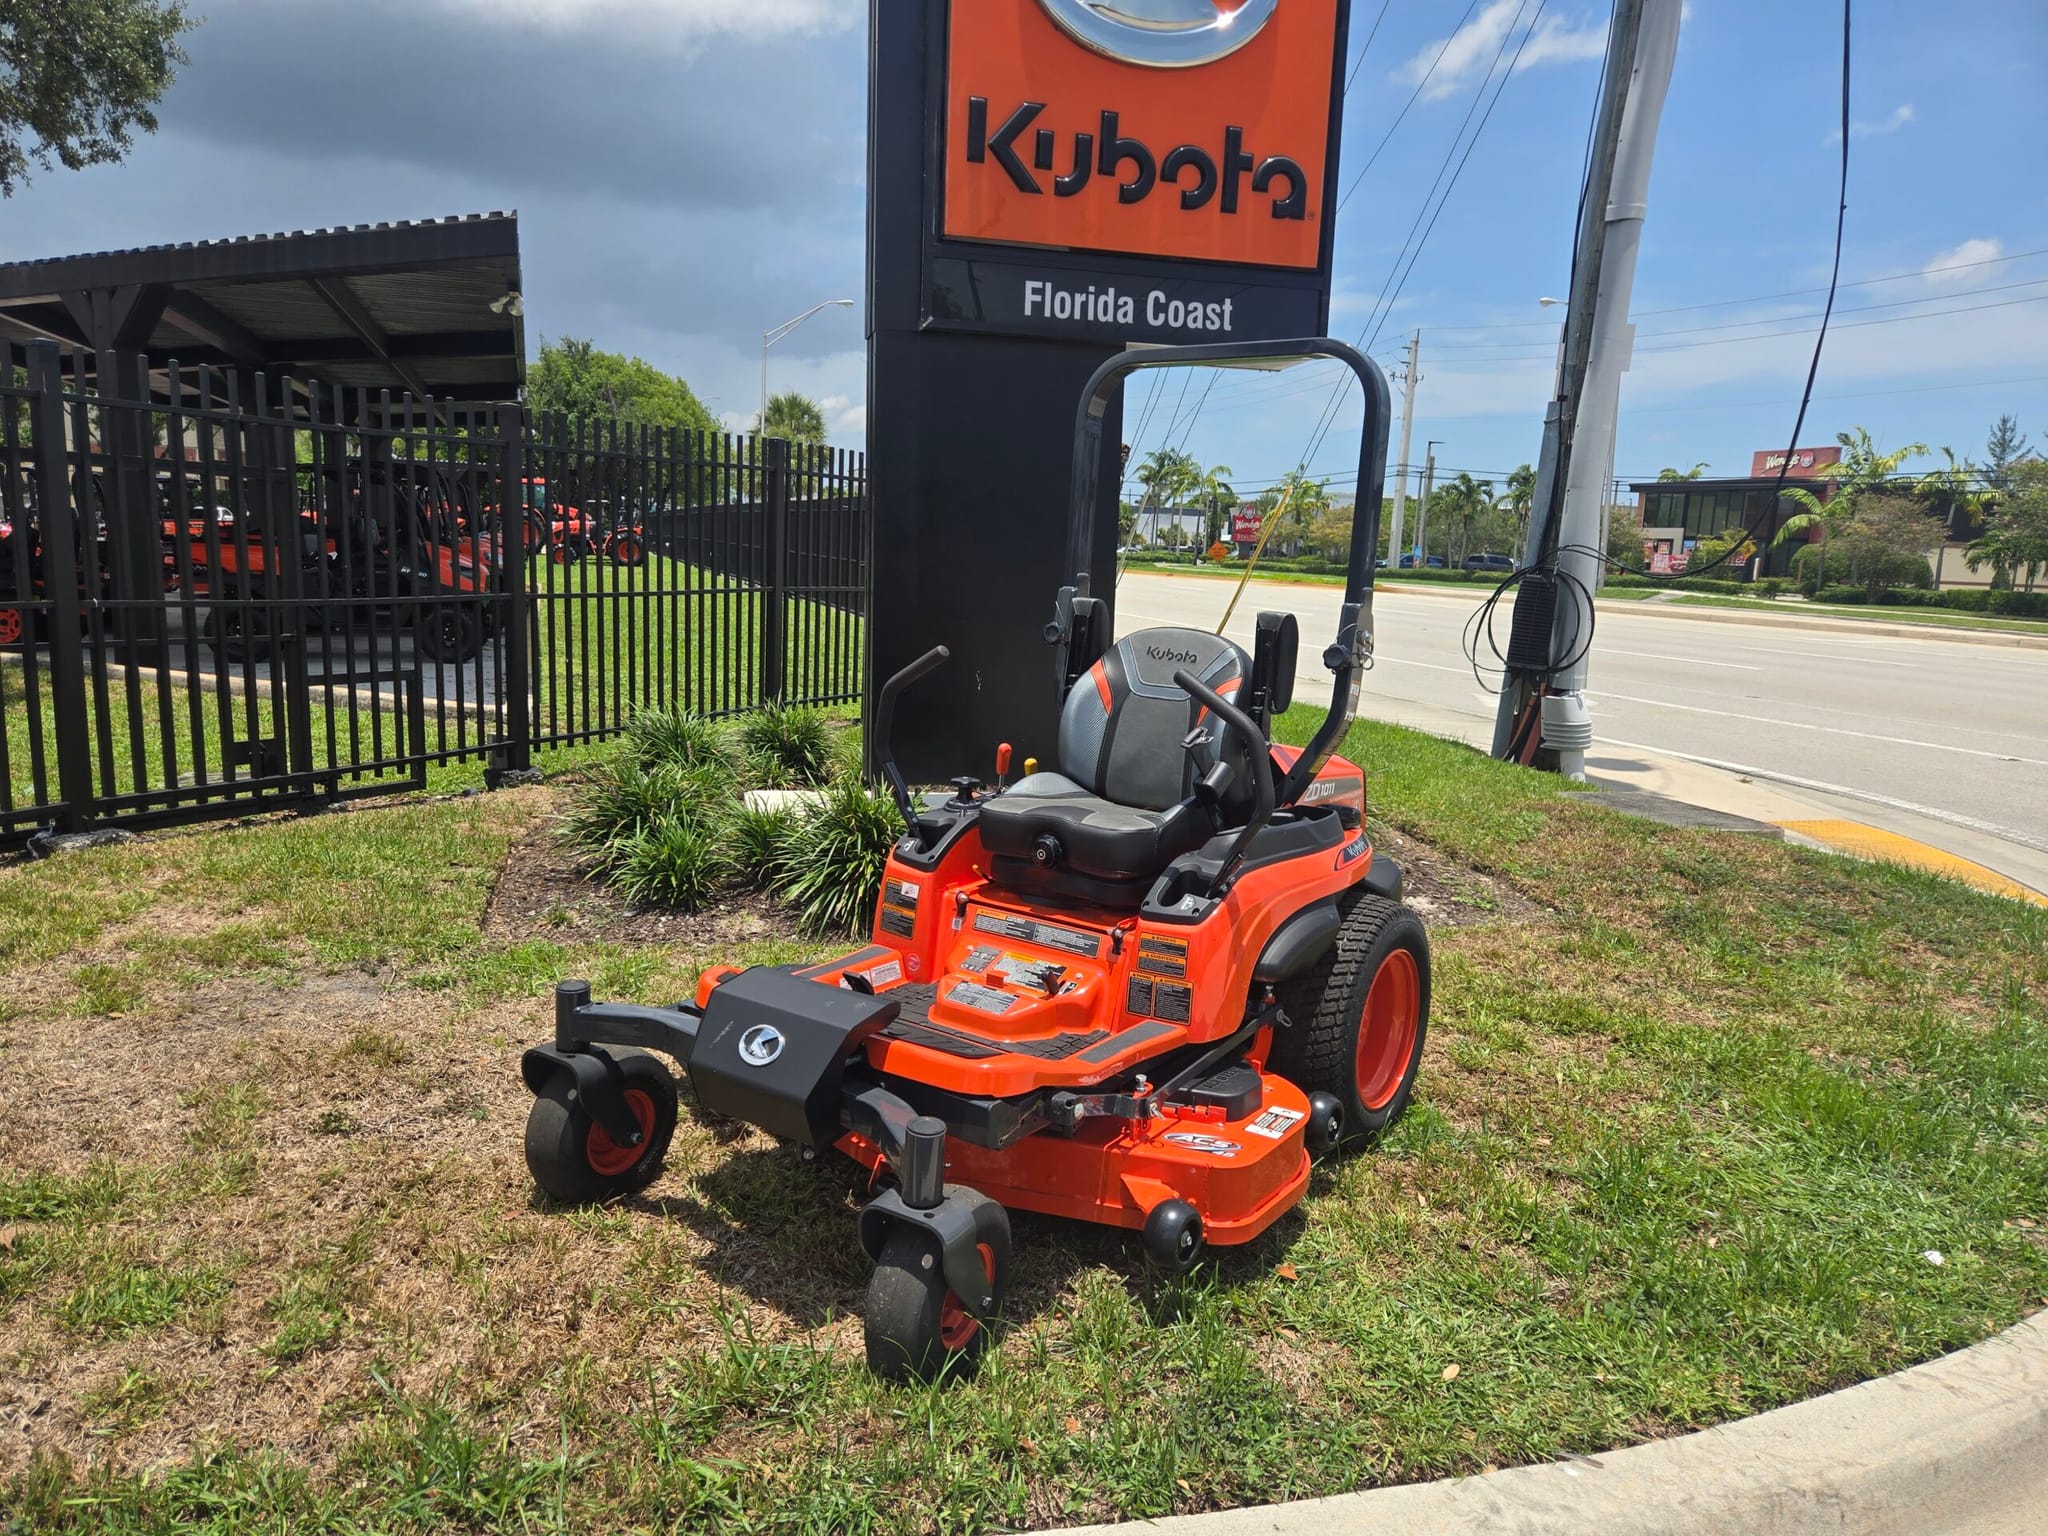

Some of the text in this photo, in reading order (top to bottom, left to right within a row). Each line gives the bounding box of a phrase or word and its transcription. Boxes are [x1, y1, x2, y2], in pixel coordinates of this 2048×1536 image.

[966, 96, 1308, 221] Kubota
[1023, 280, 1233, 331] Florida Coast
[1146, 646, 1198, 664] Kubota
[1171, 1135, 1233, 1149] ACS
